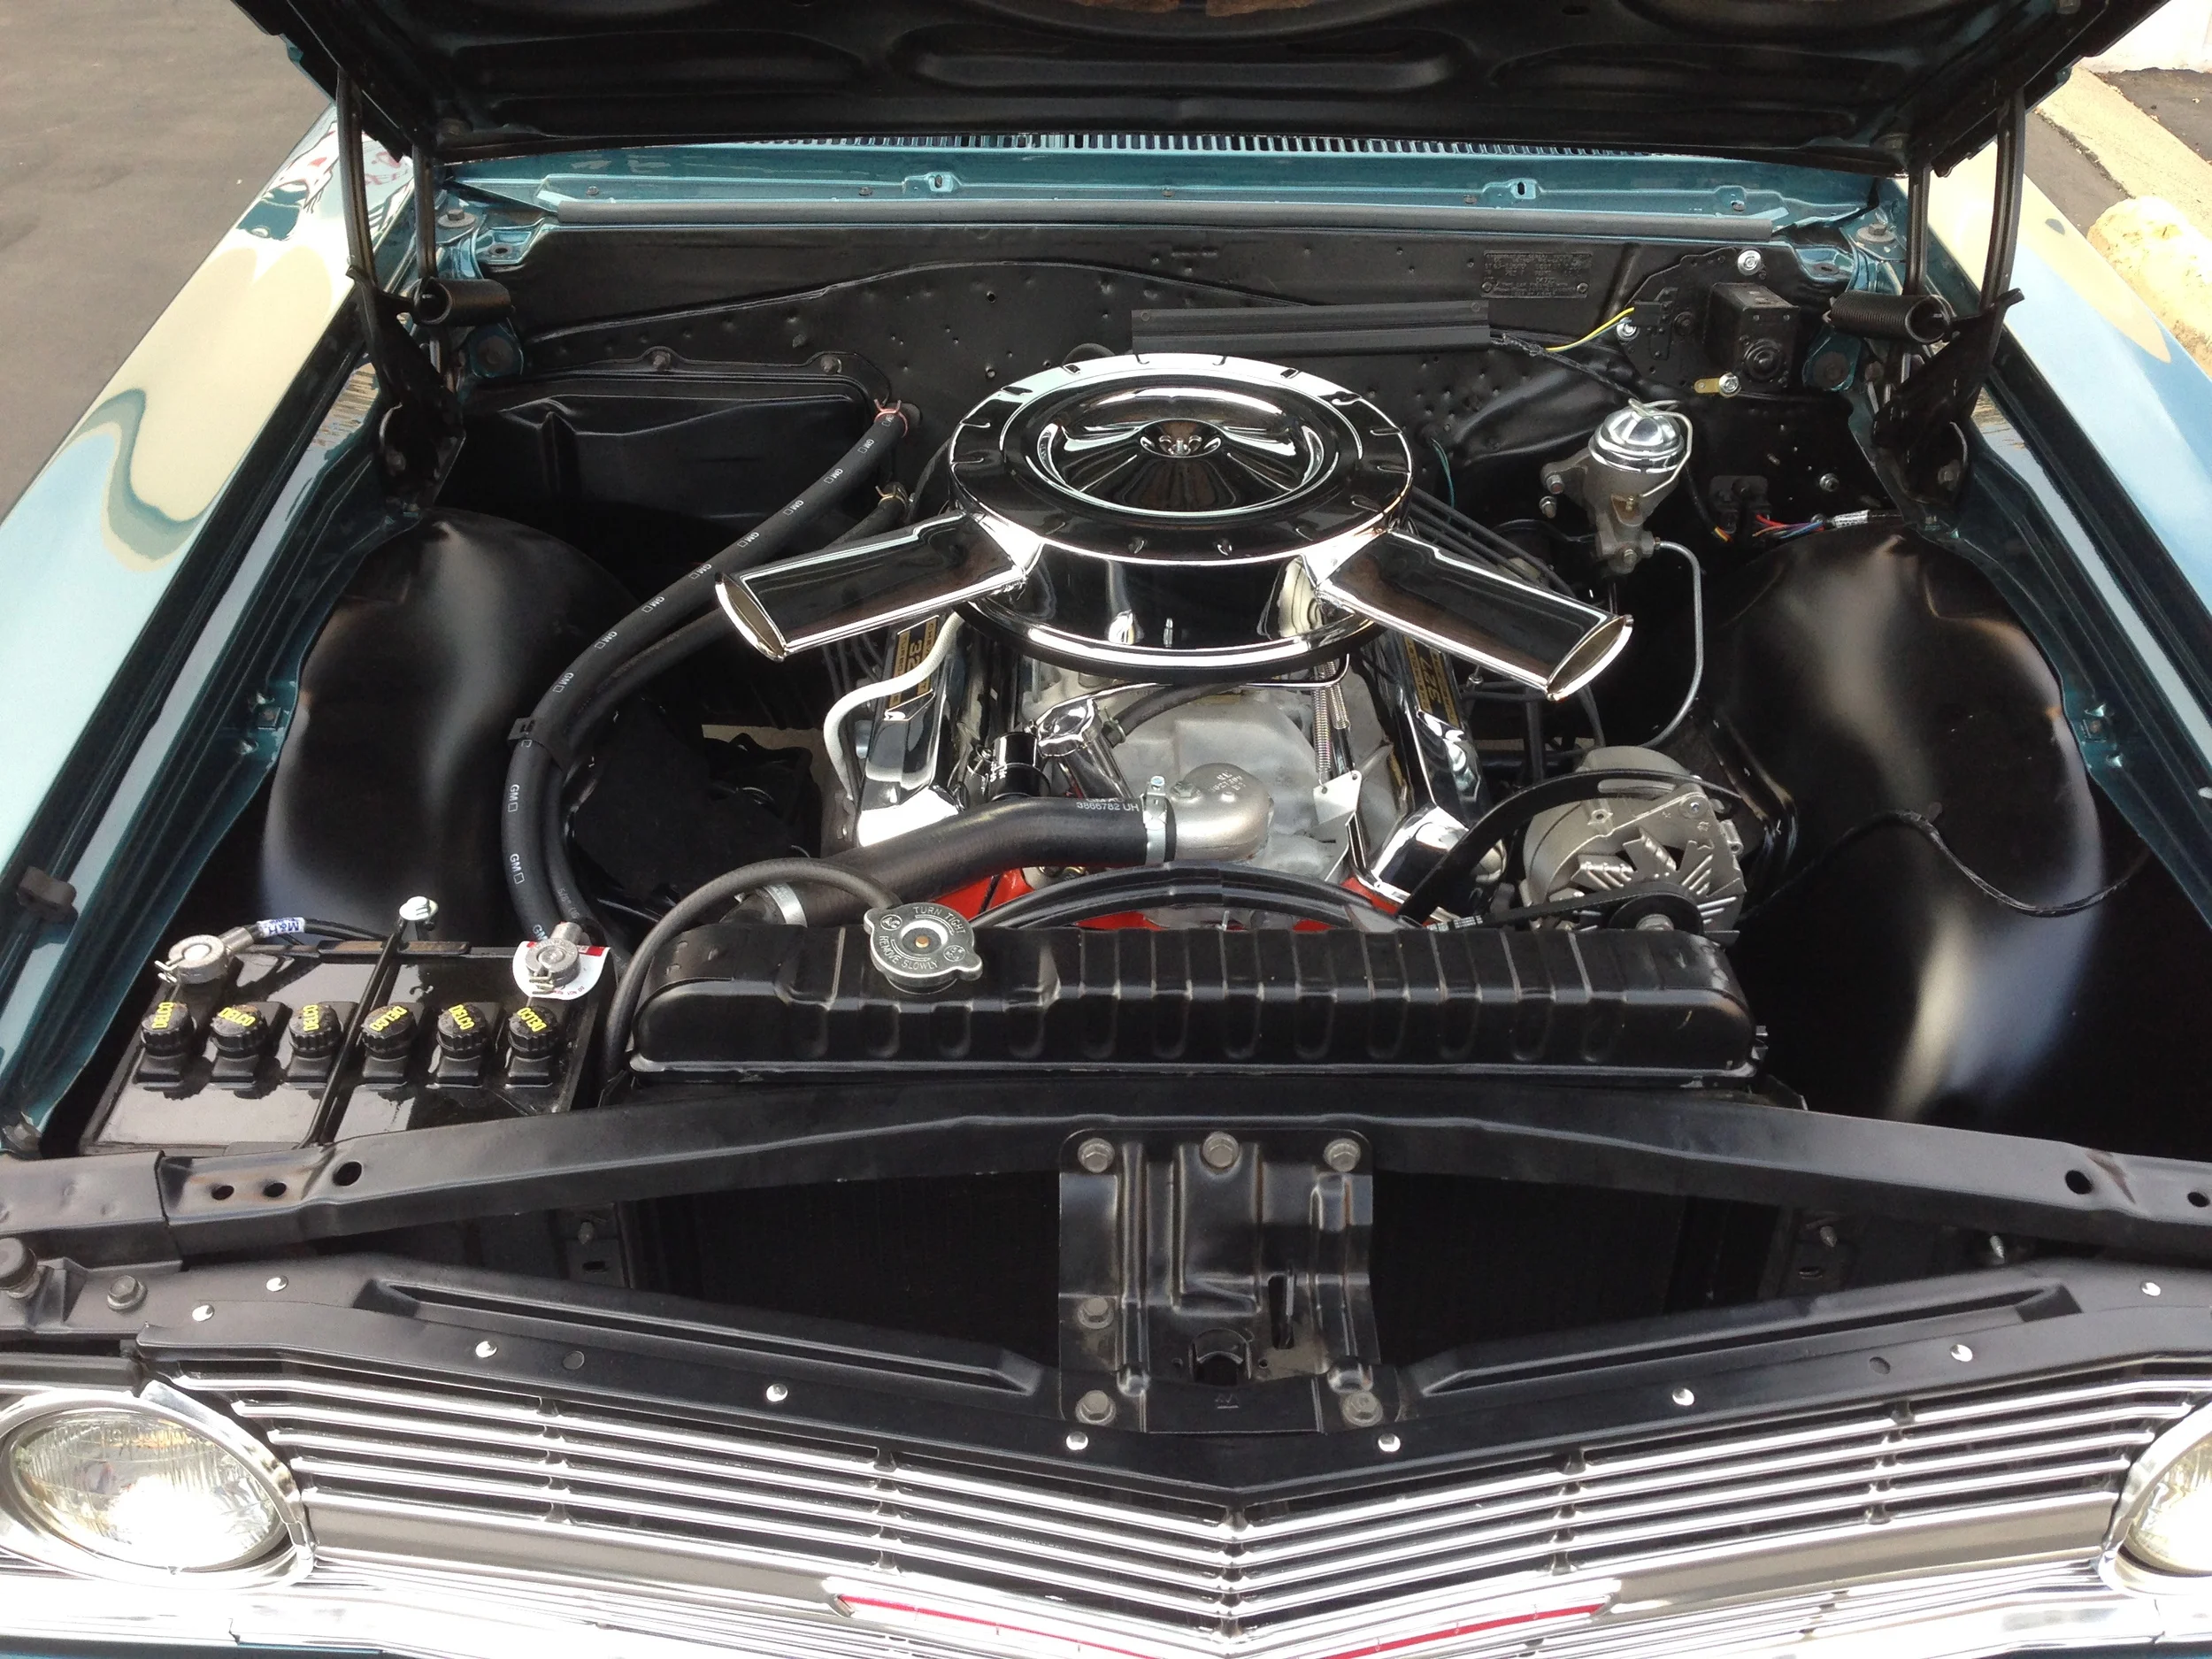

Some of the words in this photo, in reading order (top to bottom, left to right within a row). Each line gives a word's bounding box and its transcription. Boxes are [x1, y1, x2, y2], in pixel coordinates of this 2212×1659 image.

[864, 439, 875, 449] GM
[830, 468, 843, 479] GM
[791, 500, 804, 511] GM
[744, 532, 759, 543] GM
[696, 564, 712, 574] GM
[649, 596, 664, 607] GM
[601, 631, 618, 642] GM
[559, 672, 574, 685] GM
[1419, 657, 1441, 703] 327
[509, 784, 519, 801] GM
[510, 853, 522, 873] GM
[913, 906, 942, 916] TURN
[944, 912, 966, 934] TIGHT
[532, 924, 549, 942] GM
[879, 935, 902, 964] REMOVE
[902, 960, 938, 971] SLOWLY
[151, 1002, 173, 1030] DELCO
[218, 1007, 256, 1026] DELCO
[303, 1004, 319, 1033] DELCO
[370, 1005, 408, 1032] DELCO
[449, 1004, 475, 1031] DELCO
[517, 1007, 547, 1033] DELCO
